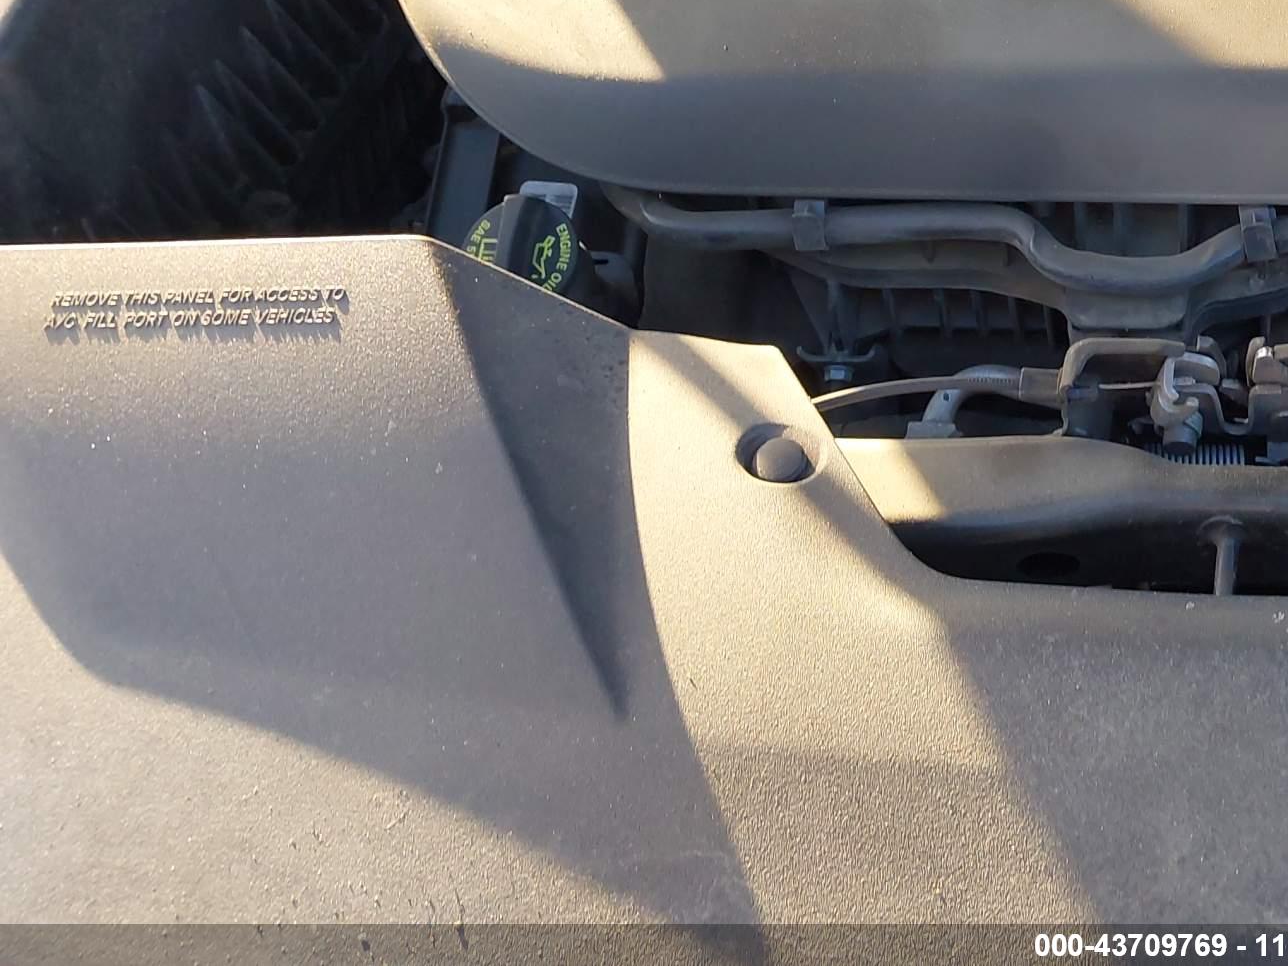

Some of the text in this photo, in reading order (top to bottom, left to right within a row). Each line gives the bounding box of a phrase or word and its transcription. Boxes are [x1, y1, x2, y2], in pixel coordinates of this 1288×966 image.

[471, 219, 491, 244] SAE
[556, 223, 572, 272] ENGINE
[543, 272, 562, 293] OIL
[50, 285, 346, 307] REMOVE THIS PANEL FOR ACCESS TO
[43, 305, 337, 329] A/C FILL PORT ON SOME VEHICLES
